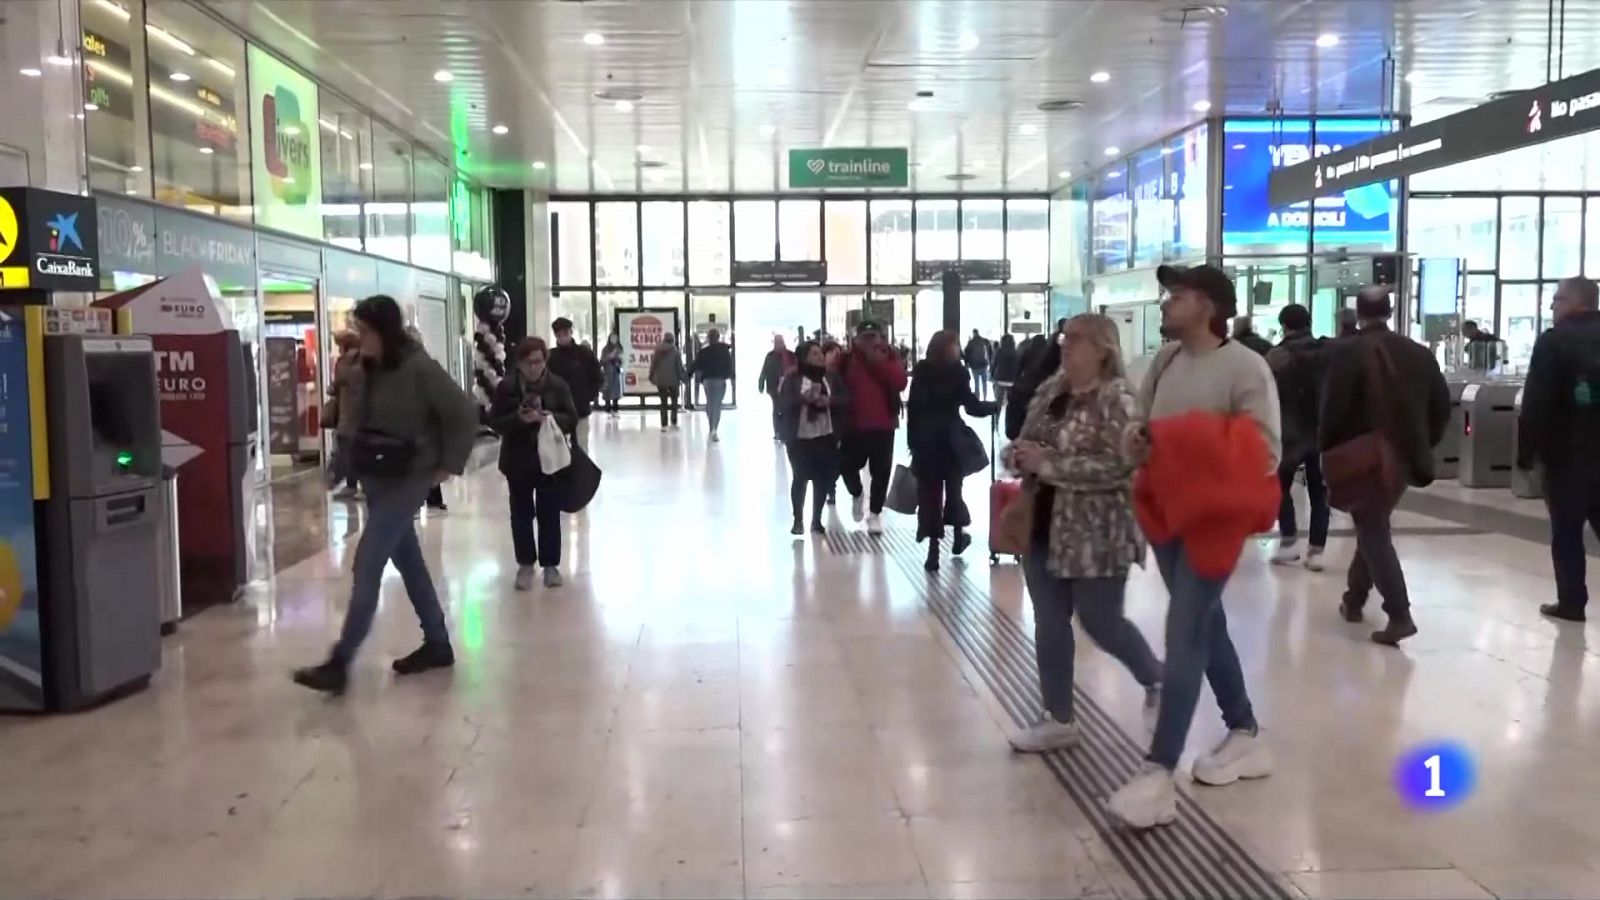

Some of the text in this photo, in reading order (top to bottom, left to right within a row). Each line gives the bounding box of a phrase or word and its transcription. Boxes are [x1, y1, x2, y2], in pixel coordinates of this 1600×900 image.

[1551, 100, 1567, 118] No
[828, 158, 890, 174] trainline
[208, 240, 252, 266] FRIDAY
[36, 257, 94, 277] CaixaBank
[174, 305, 205, 313] EURO
[153, 351, 194, 372] TM
